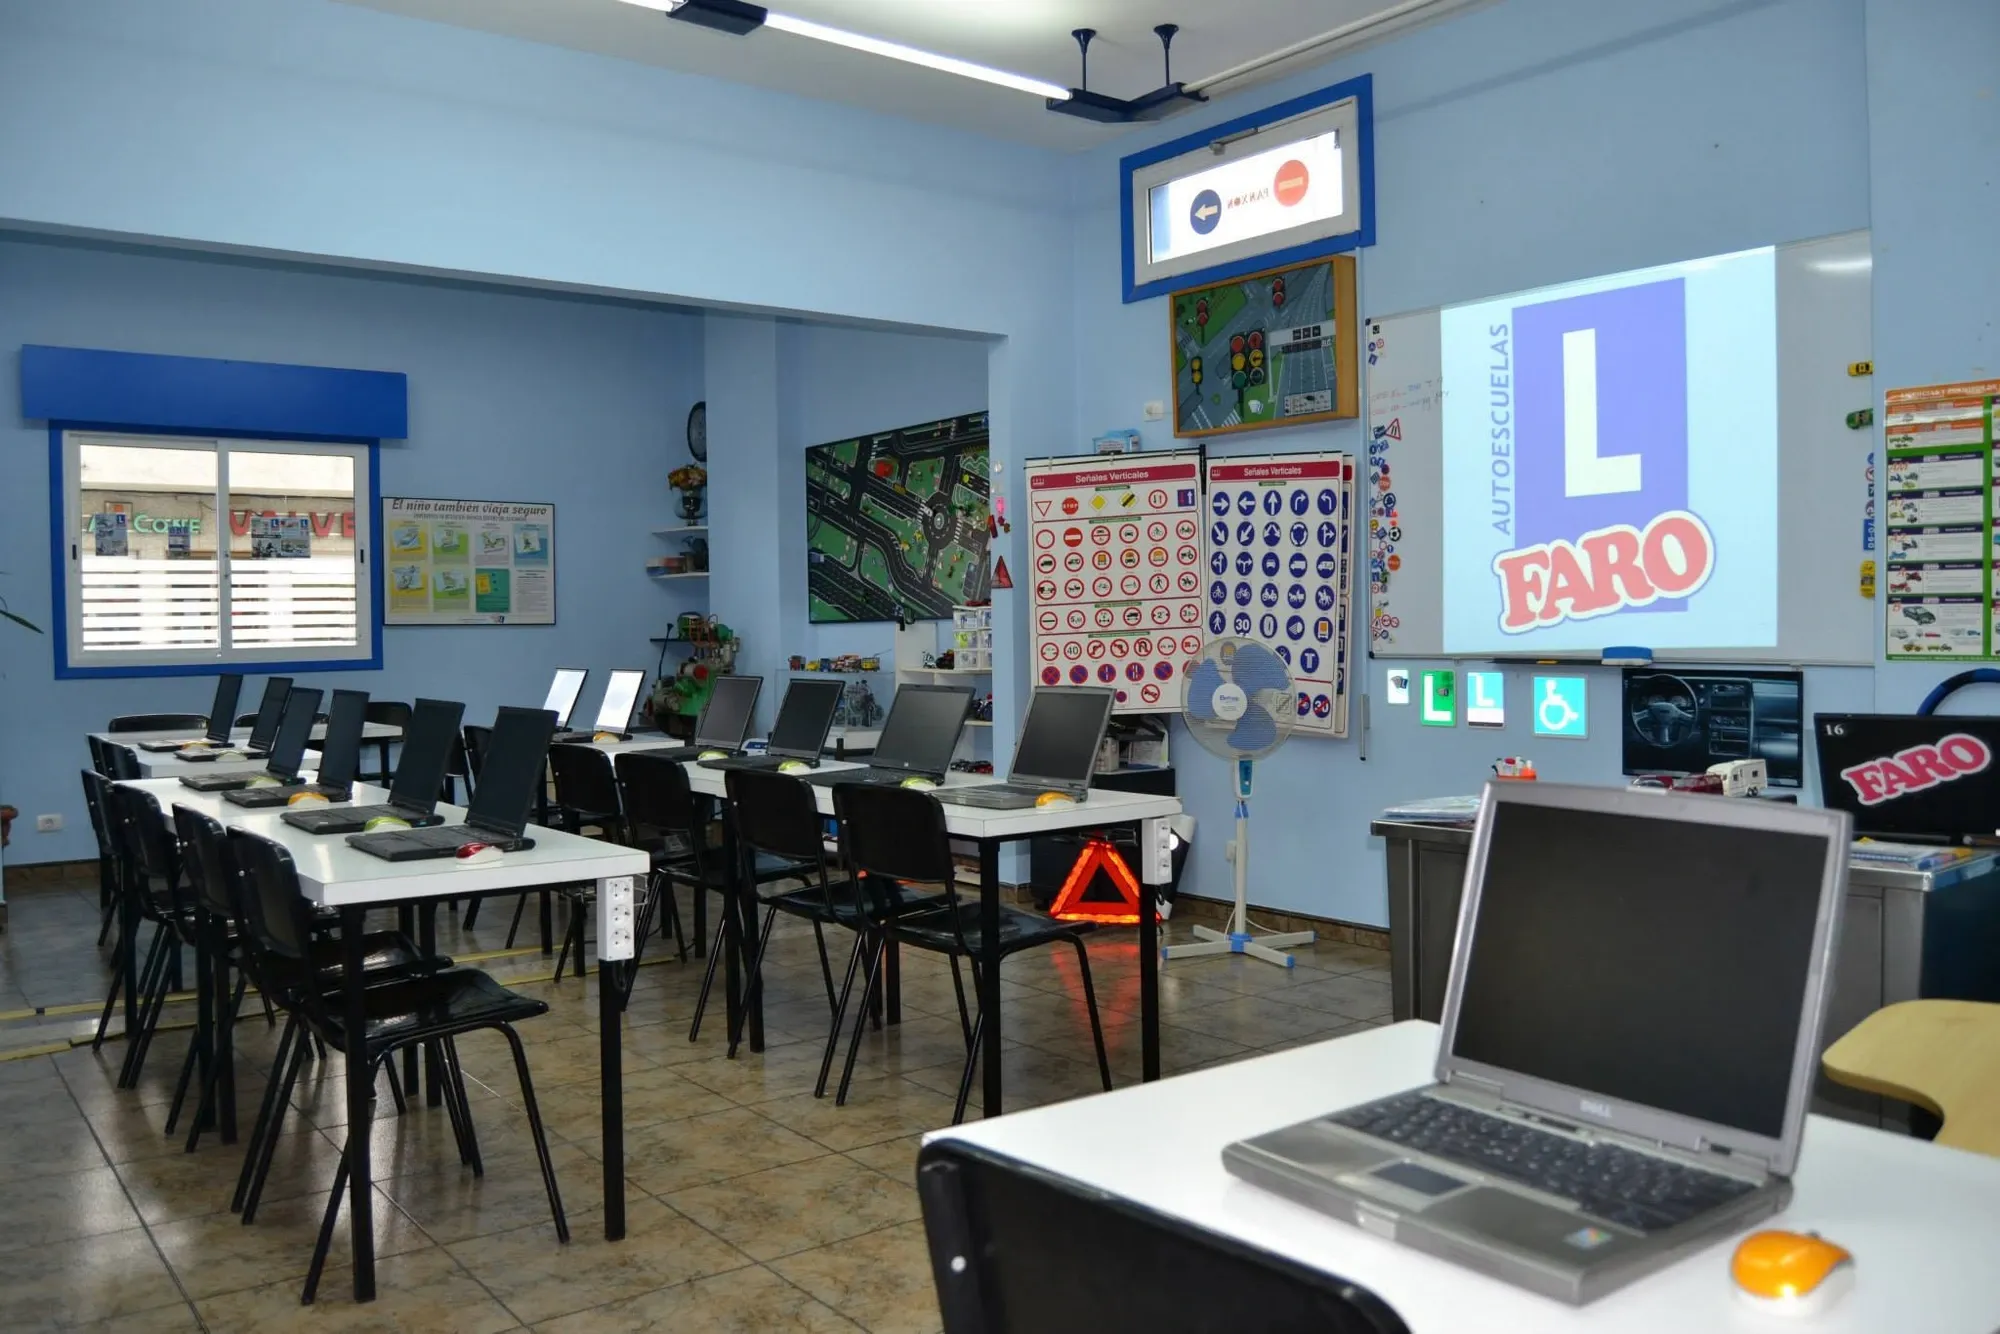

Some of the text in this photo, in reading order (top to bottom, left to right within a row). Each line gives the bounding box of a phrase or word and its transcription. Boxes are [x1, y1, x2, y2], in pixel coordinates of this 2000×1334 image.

[1563, 328, 1642, 497] L
[1490, 323, 1512, 536] AUTOESCUELAS
[1075, 470, 1149, 484] Señales Verticales
[1243, 465, 1302, 477] Señales Verticales
[392, 499, 403, 510] El
[406, 500, 431, 511] niño
[482, 504, 509, 516] viaja
[512, 506, 547, 518] seguro
[1499, 517, 1707, 627] FARO
[1235, 619, 1250, 631] 30
[1067, 646, 1080, 656] 40
[1423, 674, 1452, 721] L
[1476, 675, 1495, 707] L
[1825, 723, 1845, 736] 16
[1845, 737, 1985, 802] FARO
